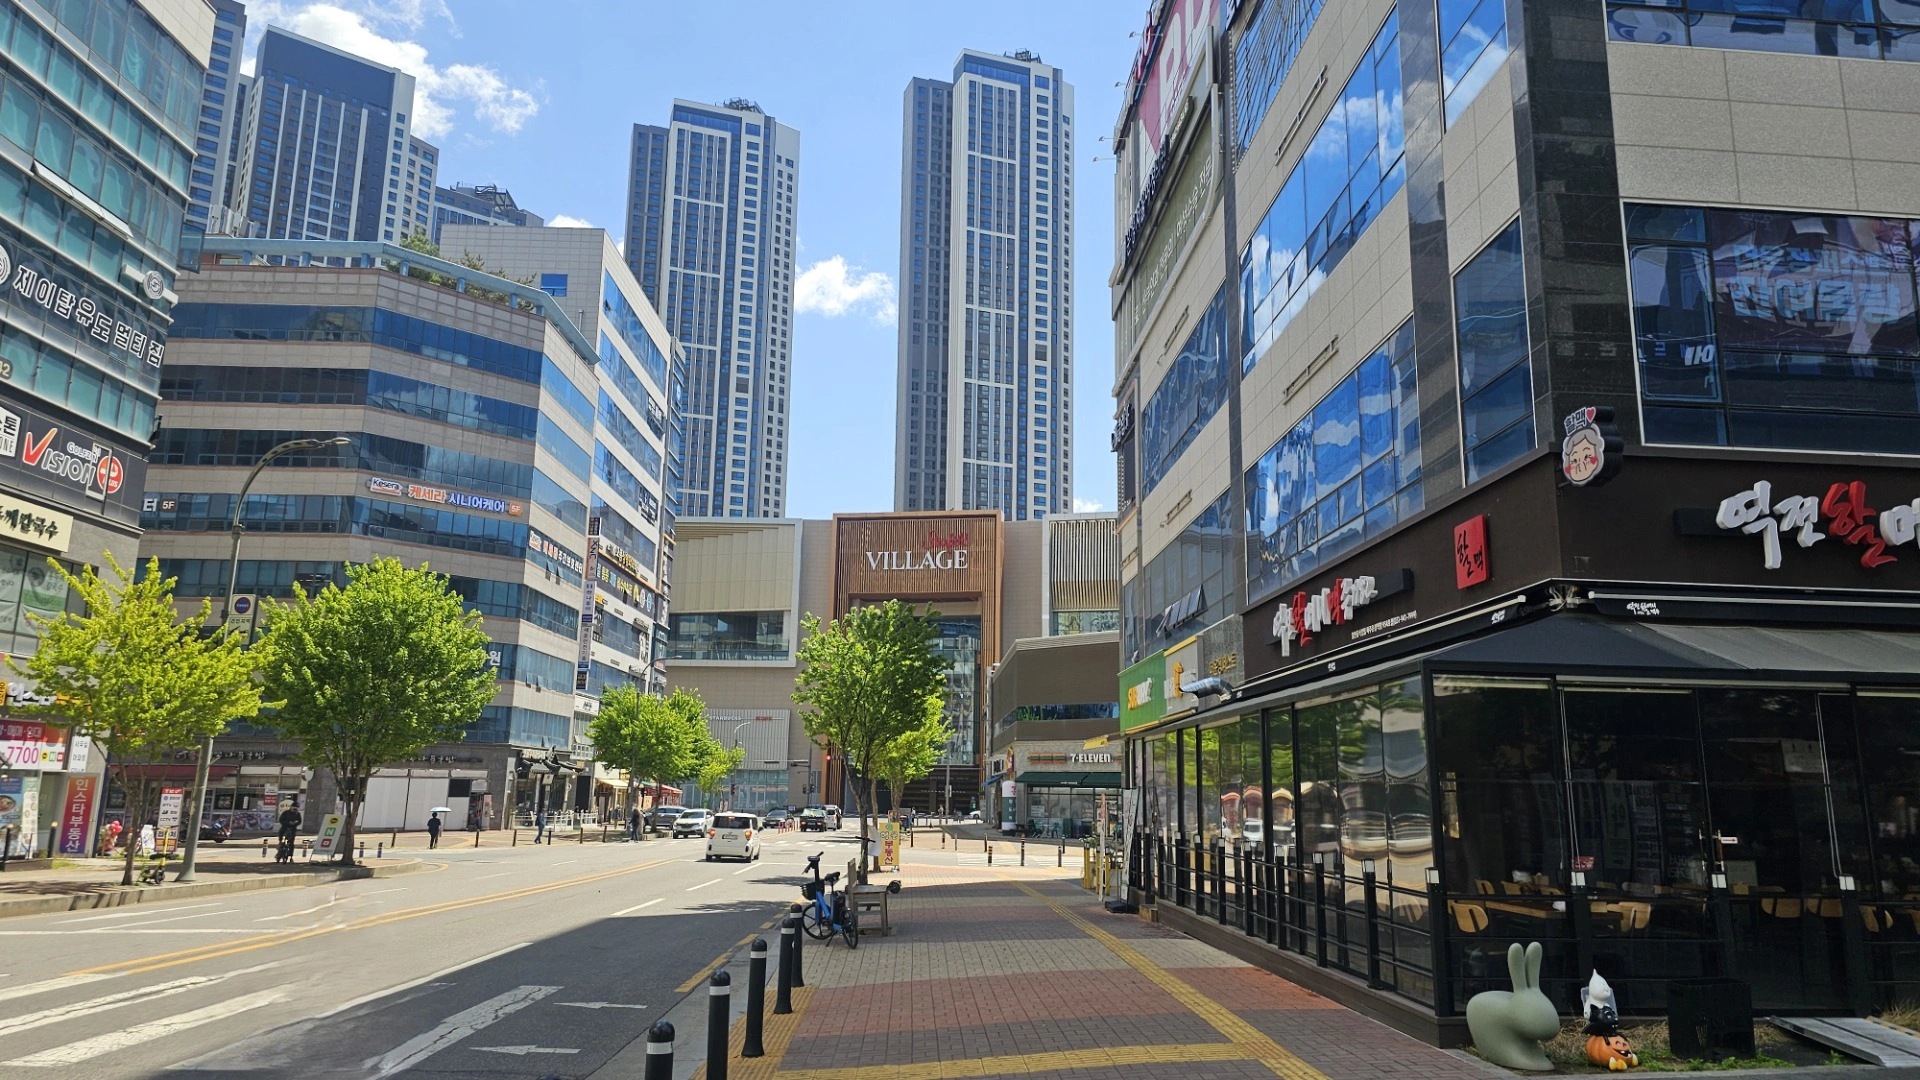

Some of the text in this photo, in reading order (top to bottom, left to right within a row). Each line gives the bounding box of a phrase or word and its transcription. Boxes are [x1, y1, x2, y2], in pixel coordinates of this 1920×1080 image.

[1564, 407, 1587, 436] 할맥
[22, 427, 97, 487] VISION
[162, 501, 175, 510] 5F
[408, 484, 447, 504] 케세라
[447, 492, 506, 513] 시니어케어
[0, 505, 59, 541] 깨칼국수
[865, 549, 968, 571] VILLAGE
[1457, 529, 1484, 579] 할맥
[488, 650, 502, 666] 원
[6, 746, 40, 764] 7700
[65, 780, 90, 853] 인스타부동산
[884, 840, 894, 865] 부동산
